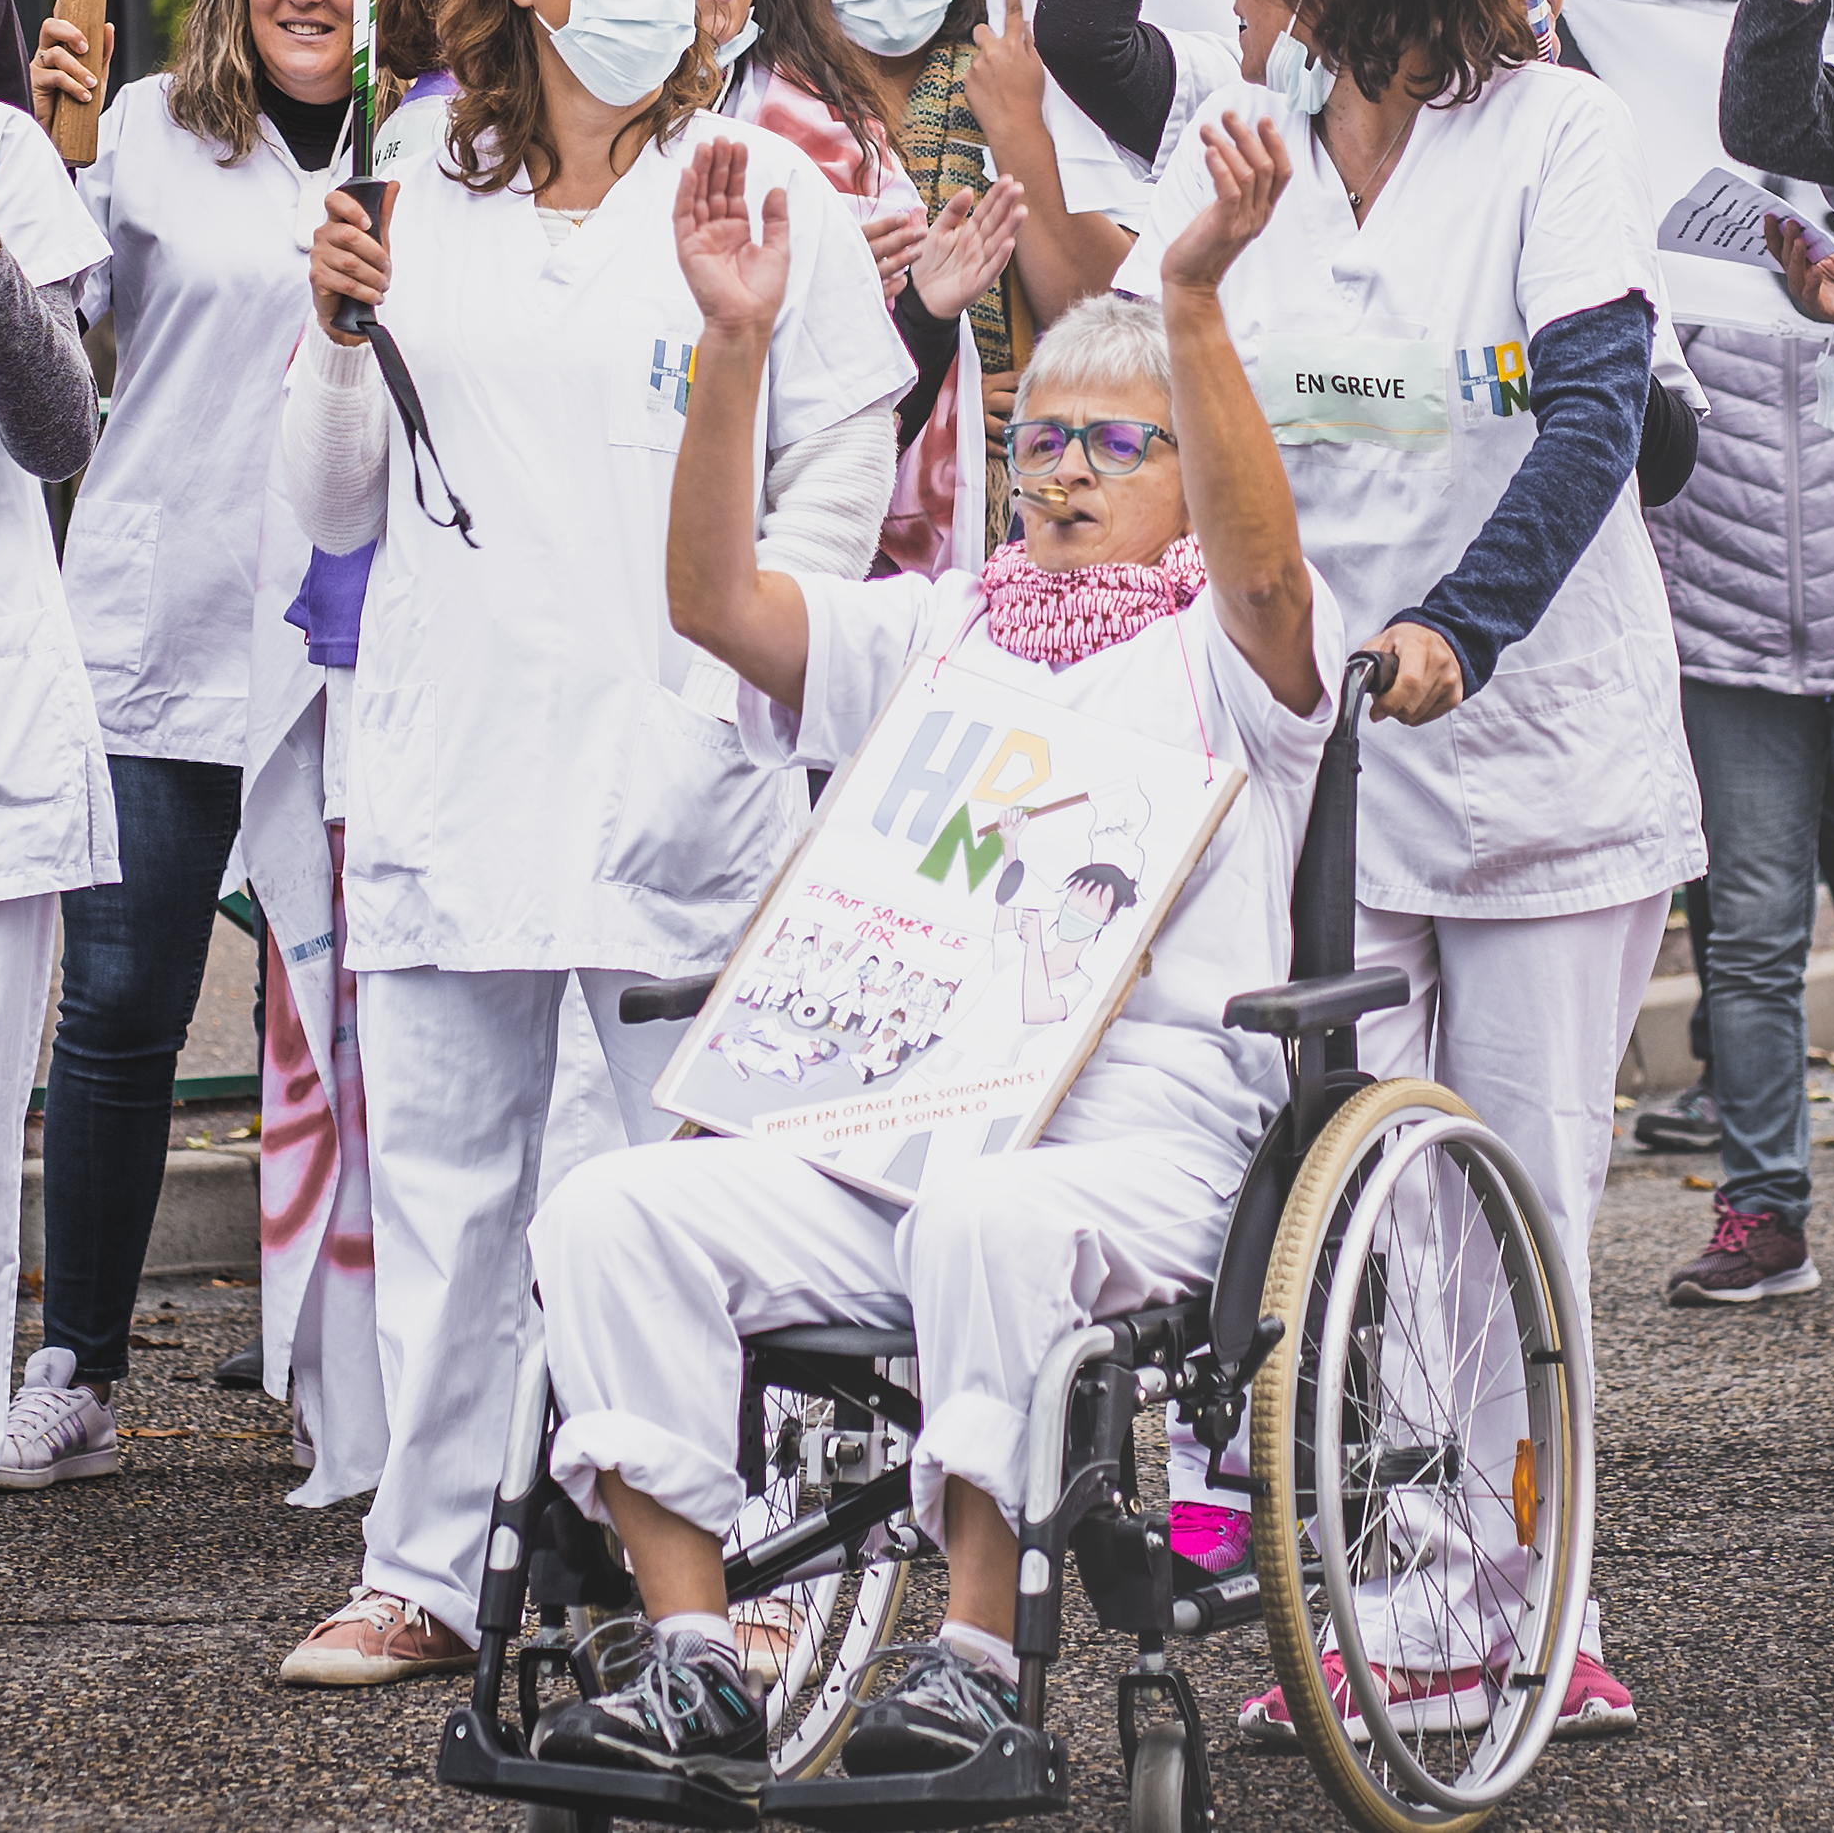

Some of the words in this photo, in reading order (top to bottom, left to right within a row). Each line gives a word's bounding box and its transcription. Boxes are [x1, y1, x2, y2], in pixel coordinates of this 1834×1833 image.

[1295, 372, 1326, 394] EN
[1330, 374, 1406, 400] GREVE
[766, 1114, 809, 1135] PRISE
[816, 1108, 837, 1124] EN
[842, 1098, 895, 1118] OTAGE
[901, 1092, 932, 1108] DES
[937, 1071, 1035, 1102] SOIGNANTS
[823, 1121, 873, 1144] OFFRE
[878, 1116, 900, 1132] DE
[904, 1106, 955, 1126] SOINS
